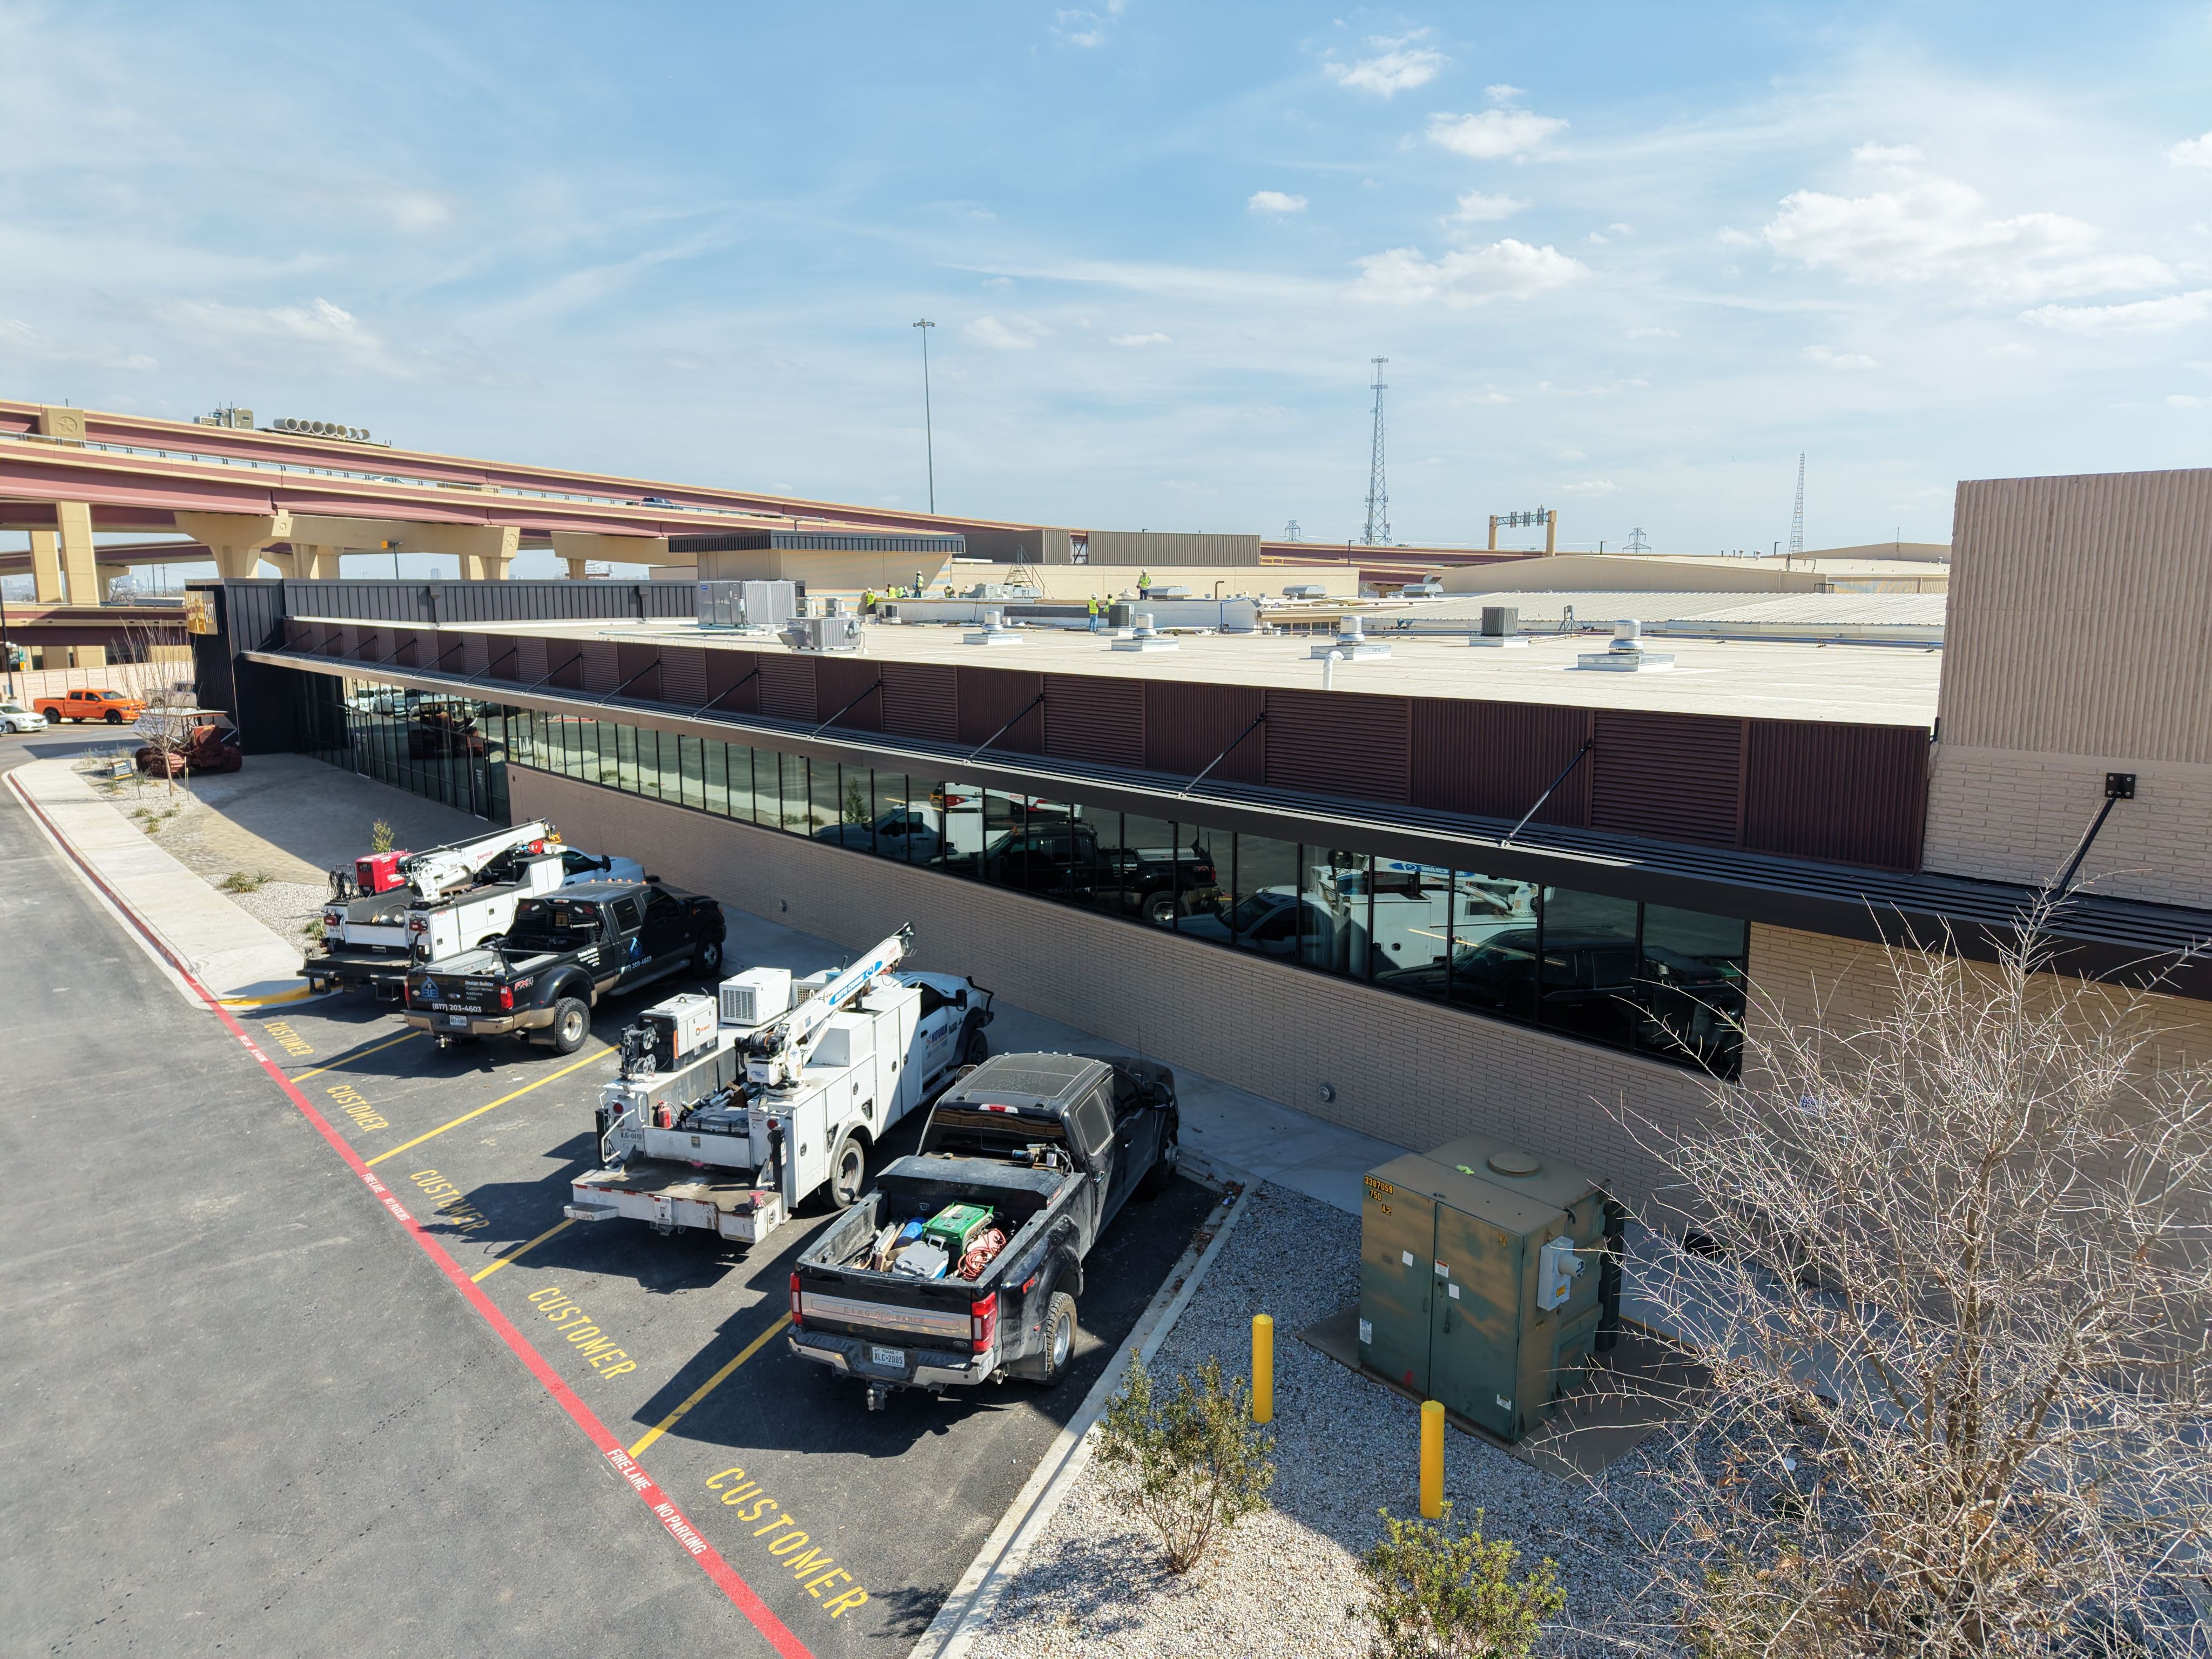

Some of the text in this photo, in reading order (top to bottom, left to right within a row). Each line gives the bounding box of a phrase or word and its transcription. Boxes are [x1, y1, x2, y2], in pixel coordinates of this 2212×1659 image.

[204, 603, 215, 624] CAT
[834, 974, 864, 1002] AUTO CRANE
[432, 1002, 482, 1013] (817) 203-4603
[264, 1022, 314, 1057] CUSTOMER
[326, 1084, 388, 1132] CUSTOMER
[1365, 1176, 1393, 1193] 3387059
[1370, 1189, 1381, 1201] 750
[410, 1170, 490, 1232] CUSTOMER
[843, 1306, 925, 1324] KING RANCH
[528, 1287, 637, 1380] CUSTOMER
[607, 1448, 707, 1555] FIRE LANE NO PARKING
[705, 1467, 869, 1618] CUSTOMER
